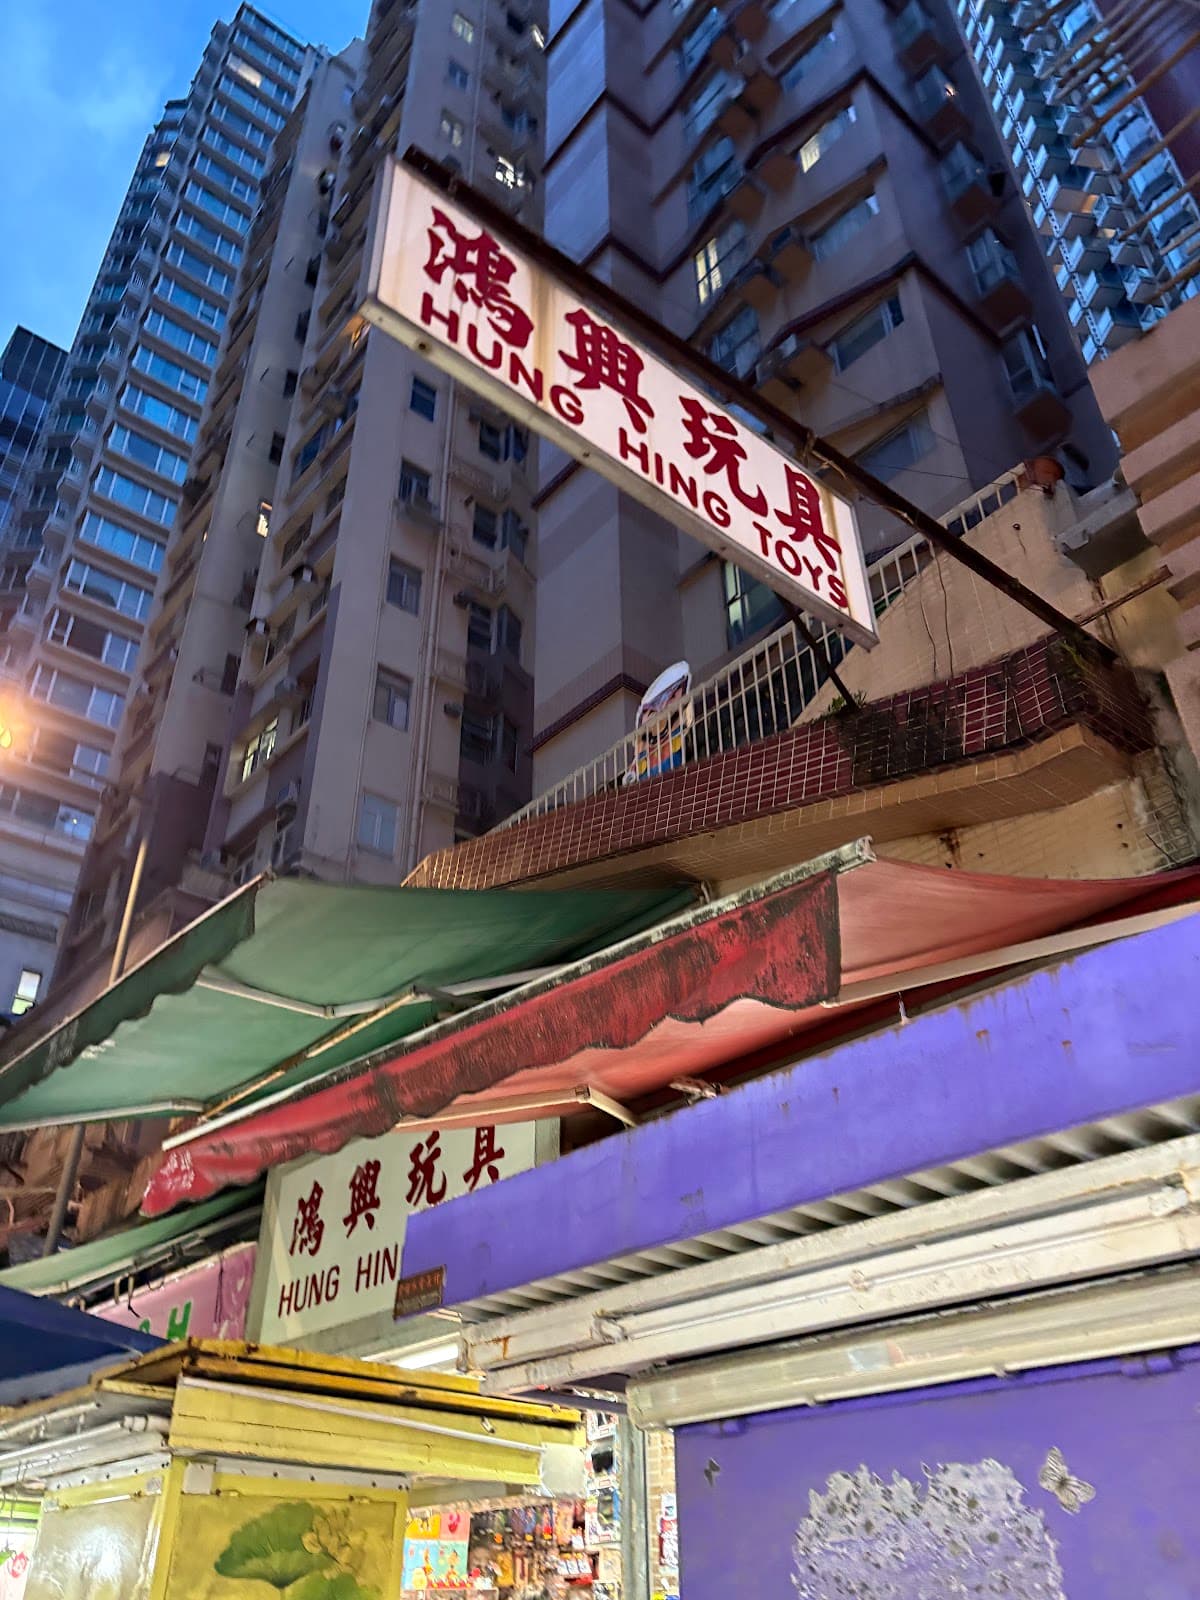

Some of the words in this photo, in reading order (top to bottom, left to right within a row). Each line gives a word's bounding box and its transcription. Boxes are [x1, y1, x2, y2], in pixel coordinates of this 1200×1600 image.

[420, 292, 585, 426] HUNG
[618, 427, 731, 528] HING
[752, 520, 850, 609] TOYS
[421, 206, 843, 571] 鴻興玩具
[278, 1265, 340, 1318] HUNG
[289, 1125, 505, 1257] 鴻興玩具
